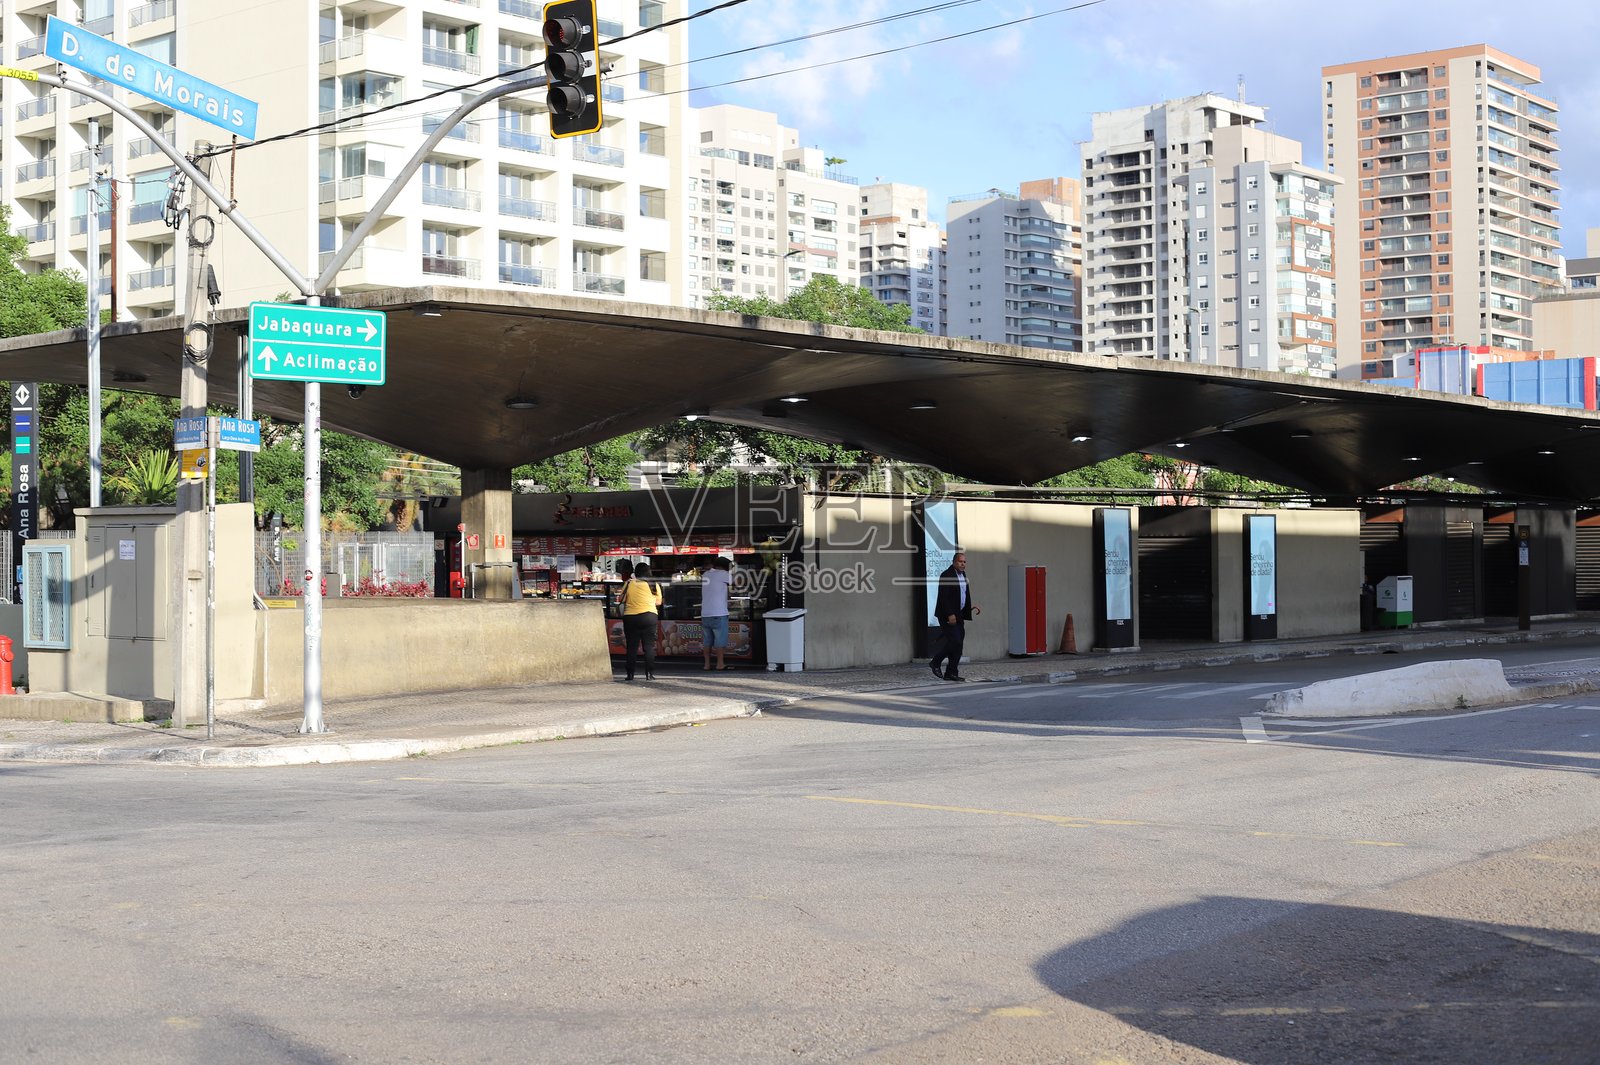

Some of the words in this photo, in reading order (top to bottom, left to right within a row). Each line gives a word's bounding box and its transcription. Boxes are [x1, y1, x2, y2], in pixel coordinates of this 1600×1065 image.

[61, 31, 84, 61] D.
[105, 54, 136, 81] de
[154, 70, 244, 127] Morais
[258, 315, 352, 337] Jabaquara
[283, 352, 377, 373] Aclimação
[176, 421, 187, 432] Ana
[189, 419, 203, 431] Rosa
[222, 418, 235, 432] Ana
[238, 420, 255, 434] Rosa
[18, 464, 29, 506] Rosa
[18, 508, 29, 539] Ana
